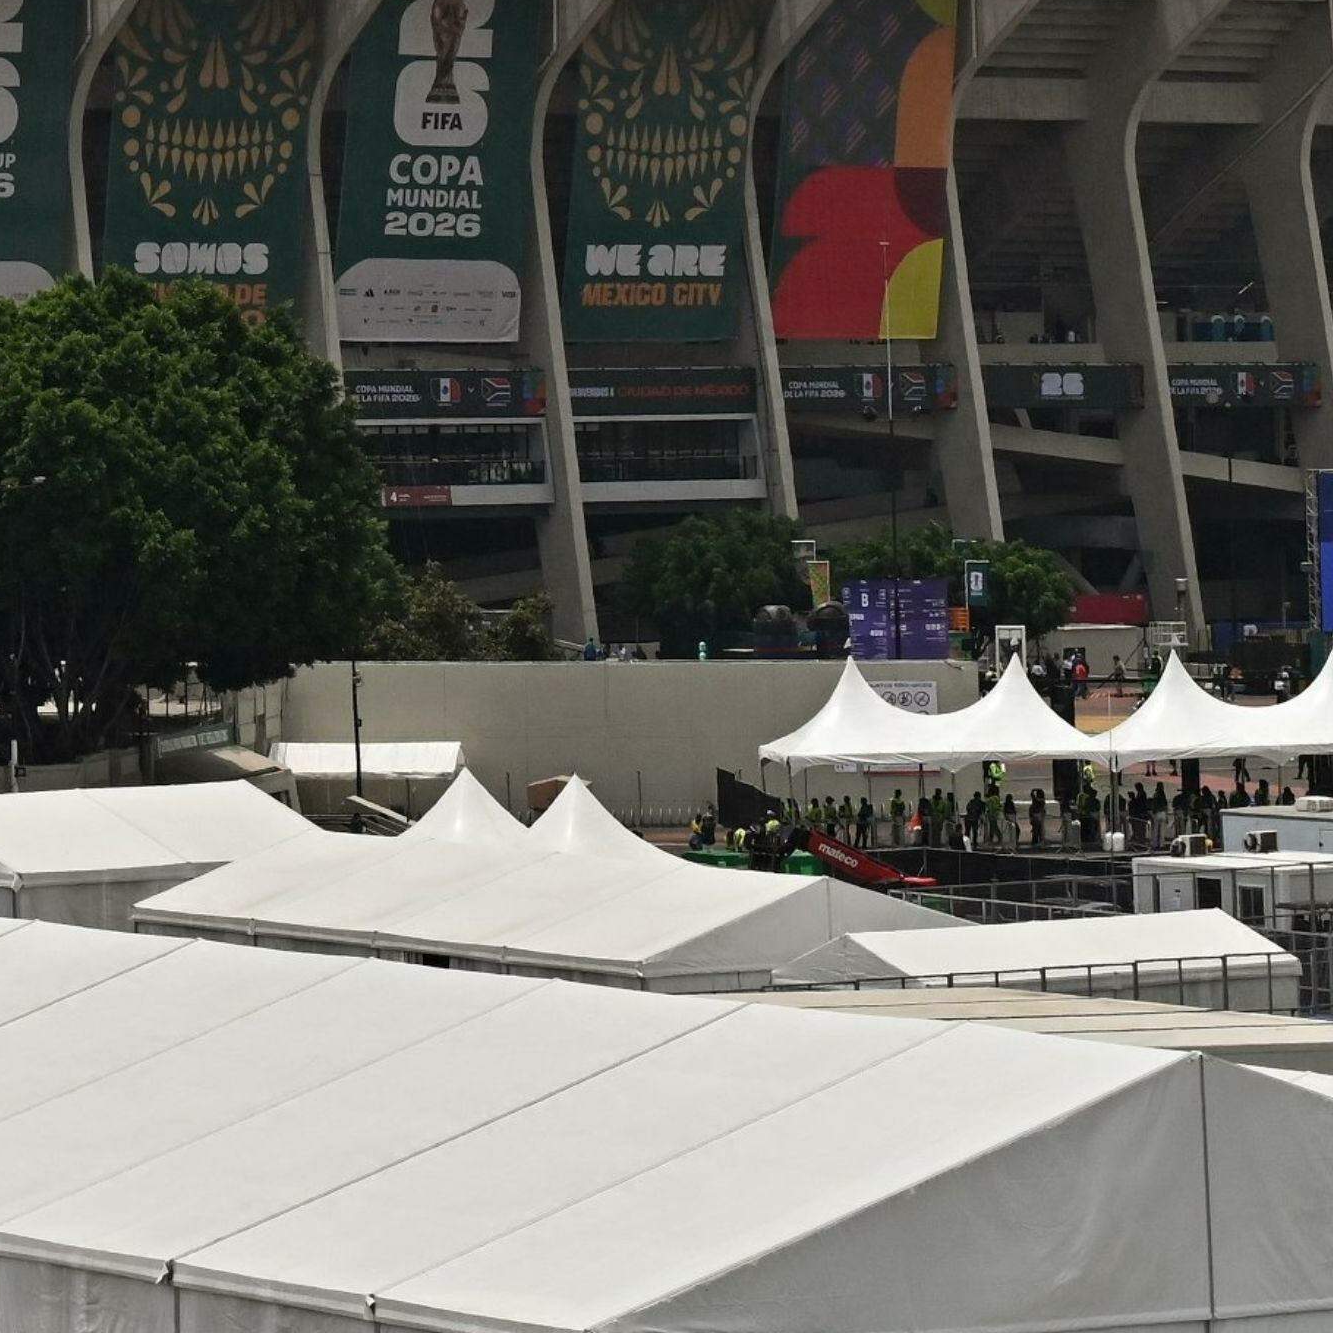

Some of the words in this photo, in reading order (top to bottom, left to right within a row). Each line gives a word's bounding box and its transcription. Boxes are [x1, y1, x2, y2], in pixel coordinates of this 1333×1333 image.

[421, 112, 463, 131] FIFA
[388, 153, 484, 186] COPA
[386, 188, 482, 209] MUNDIAL
[384, 211, 482, 237] 2026
[133, 241, 269, 275] SOMOS
[585, 244, 642, 276] WE
[672, 282, 722, 306] CITY
[355, 385, 377, 394] COPA
[378, 385, 414, 393] MUNDIAL
[788, 381, 808, 389] COPA
[809, 381, 840, 389] MUNDIAL
[795, 390, 804, 398] LA
[362, 394, 372, 403] LA
[818, 843, 859, 868] mateco
